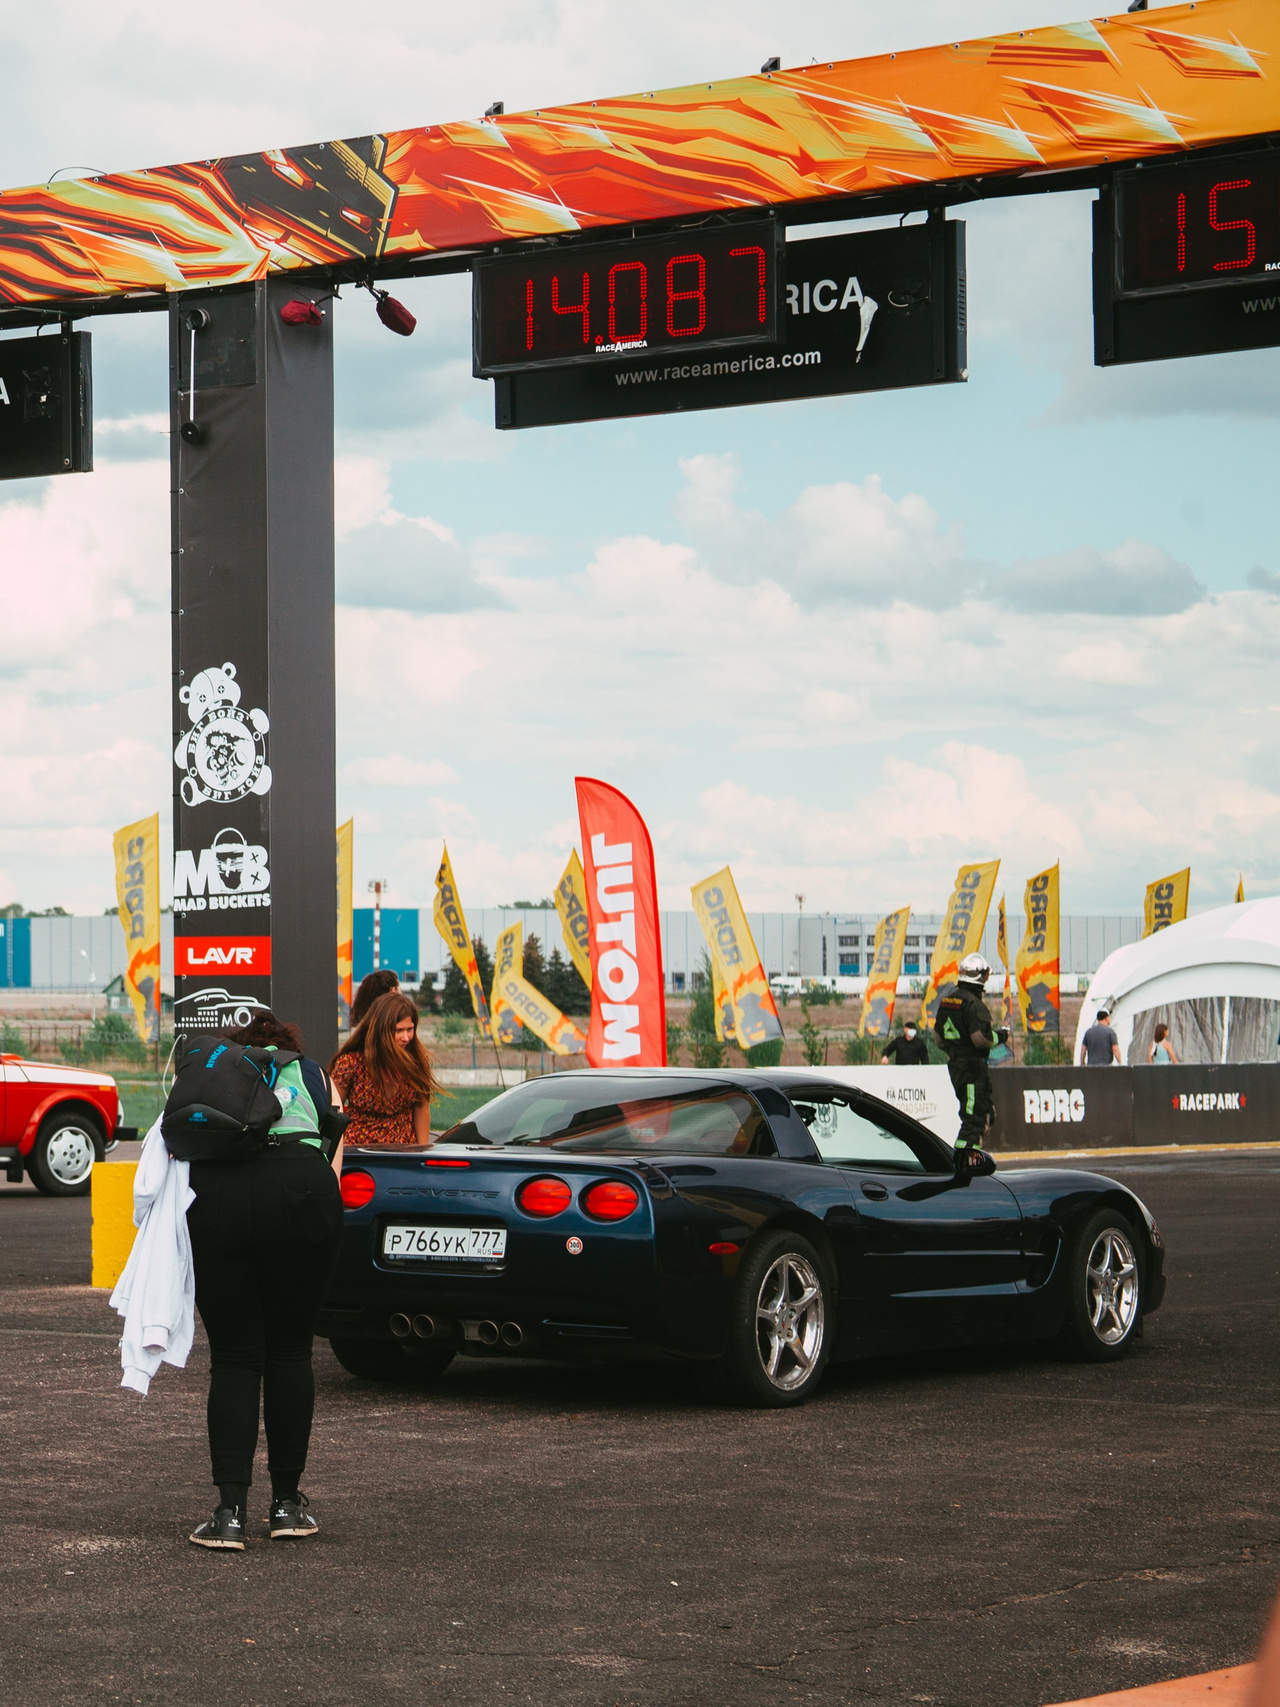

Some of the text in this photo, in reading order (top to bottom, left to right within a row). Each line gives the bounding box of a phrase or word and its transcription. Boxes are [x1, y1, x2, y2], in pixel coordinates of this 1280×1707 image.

[526, 246, 765, 351] 14.087
[615, 349, 821, 386] www.raceamerica.com
[174, 893, 271, 912] MAD BUCKETS
[886, 1088, 926, 1101] FIA ACTION
[1179, 1092, 1240, 1111] RACEPARK
[914, 1103, 938, 1114] SAFETY
[386, 1187, 500, 1199] CORVETTE
[471, 1231, 500, 1248] 777
